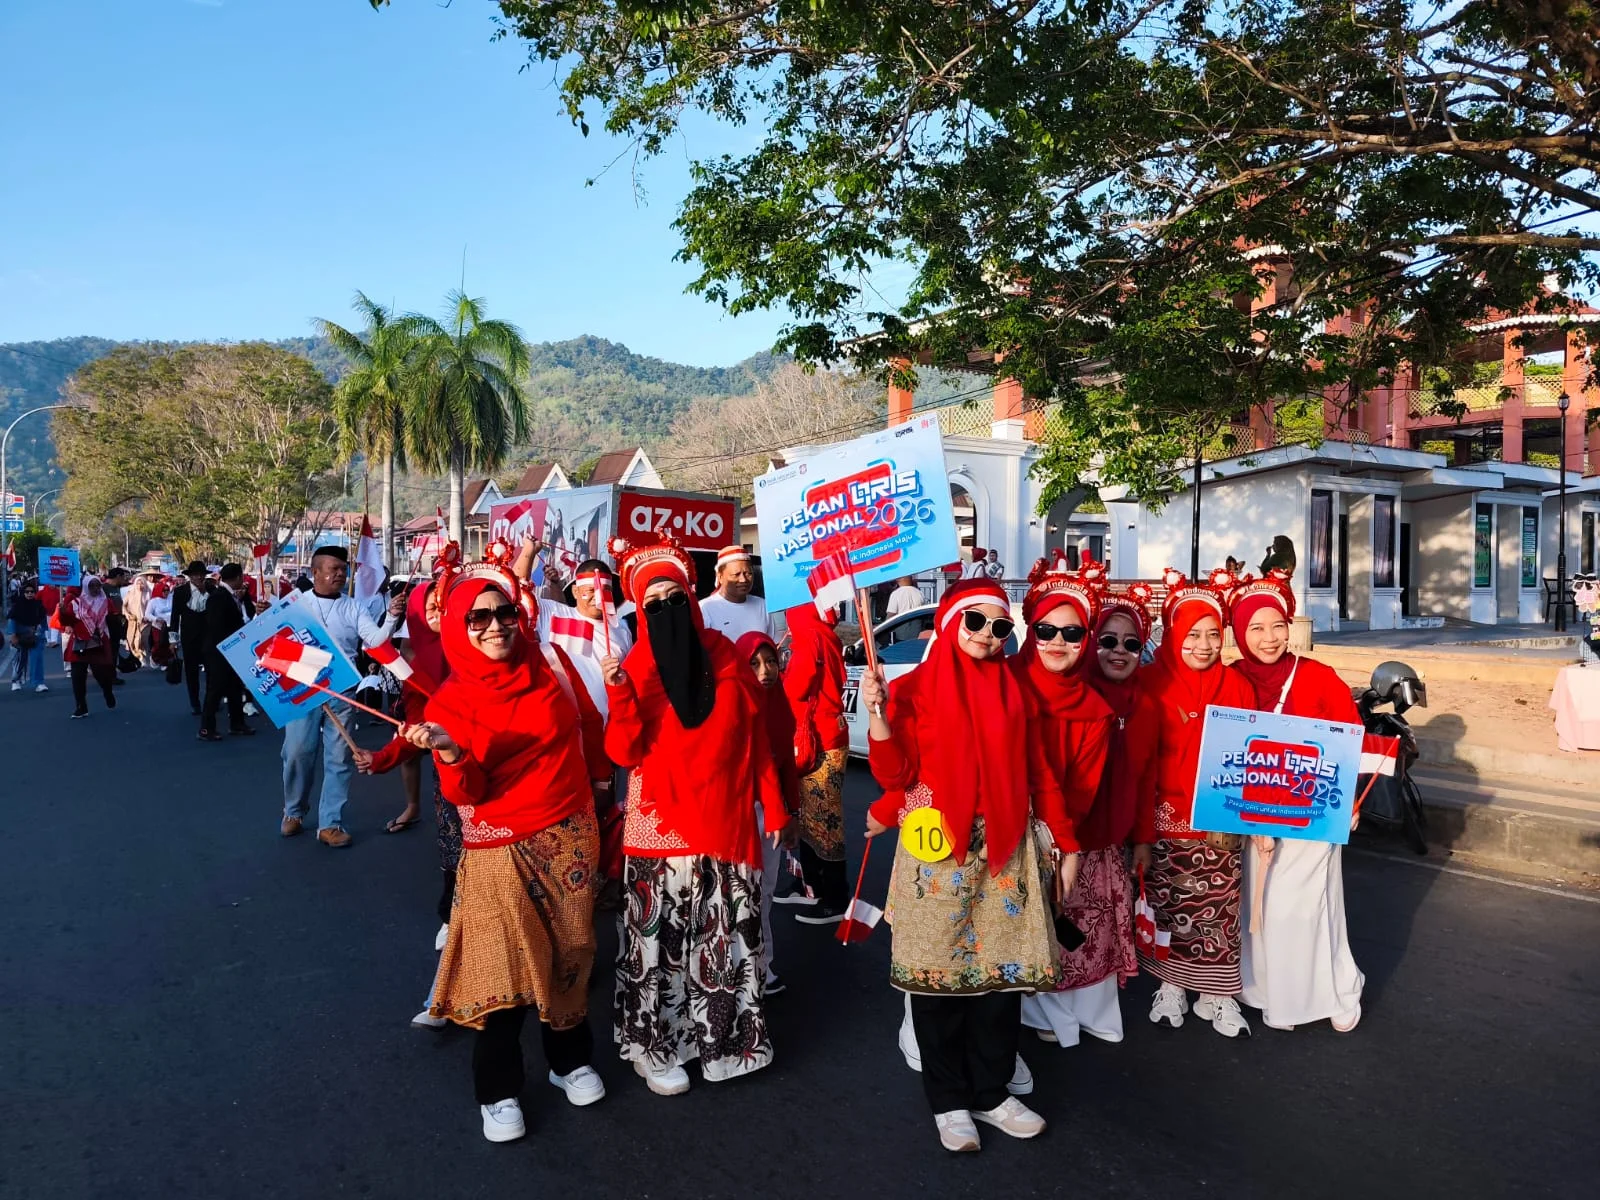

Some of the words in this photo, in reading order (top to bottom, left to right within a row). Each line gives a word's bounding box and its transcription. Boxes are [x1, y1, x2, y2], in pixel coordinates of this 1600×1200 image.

[780, 492, 847, 533] PEKAN
[848, 469, 920, 507] QRIS
[773, 511, 866, 561] NASIONAL
[866, 498, 935, 530] 2026
[859, 542, 894, 559] Indonesia
[894, 534, 913, 547] Maju
[1047, 580, 1088, 595] Indonesia
[1221, 751, 1280, 768] PEKAN
[1284, 750, 1337, 780] QRIS
[1209, 771, 1290, 788] NASIONAL
[1290, 775, 1343, 804] 2026
[913, 825, 944, 852] 10
